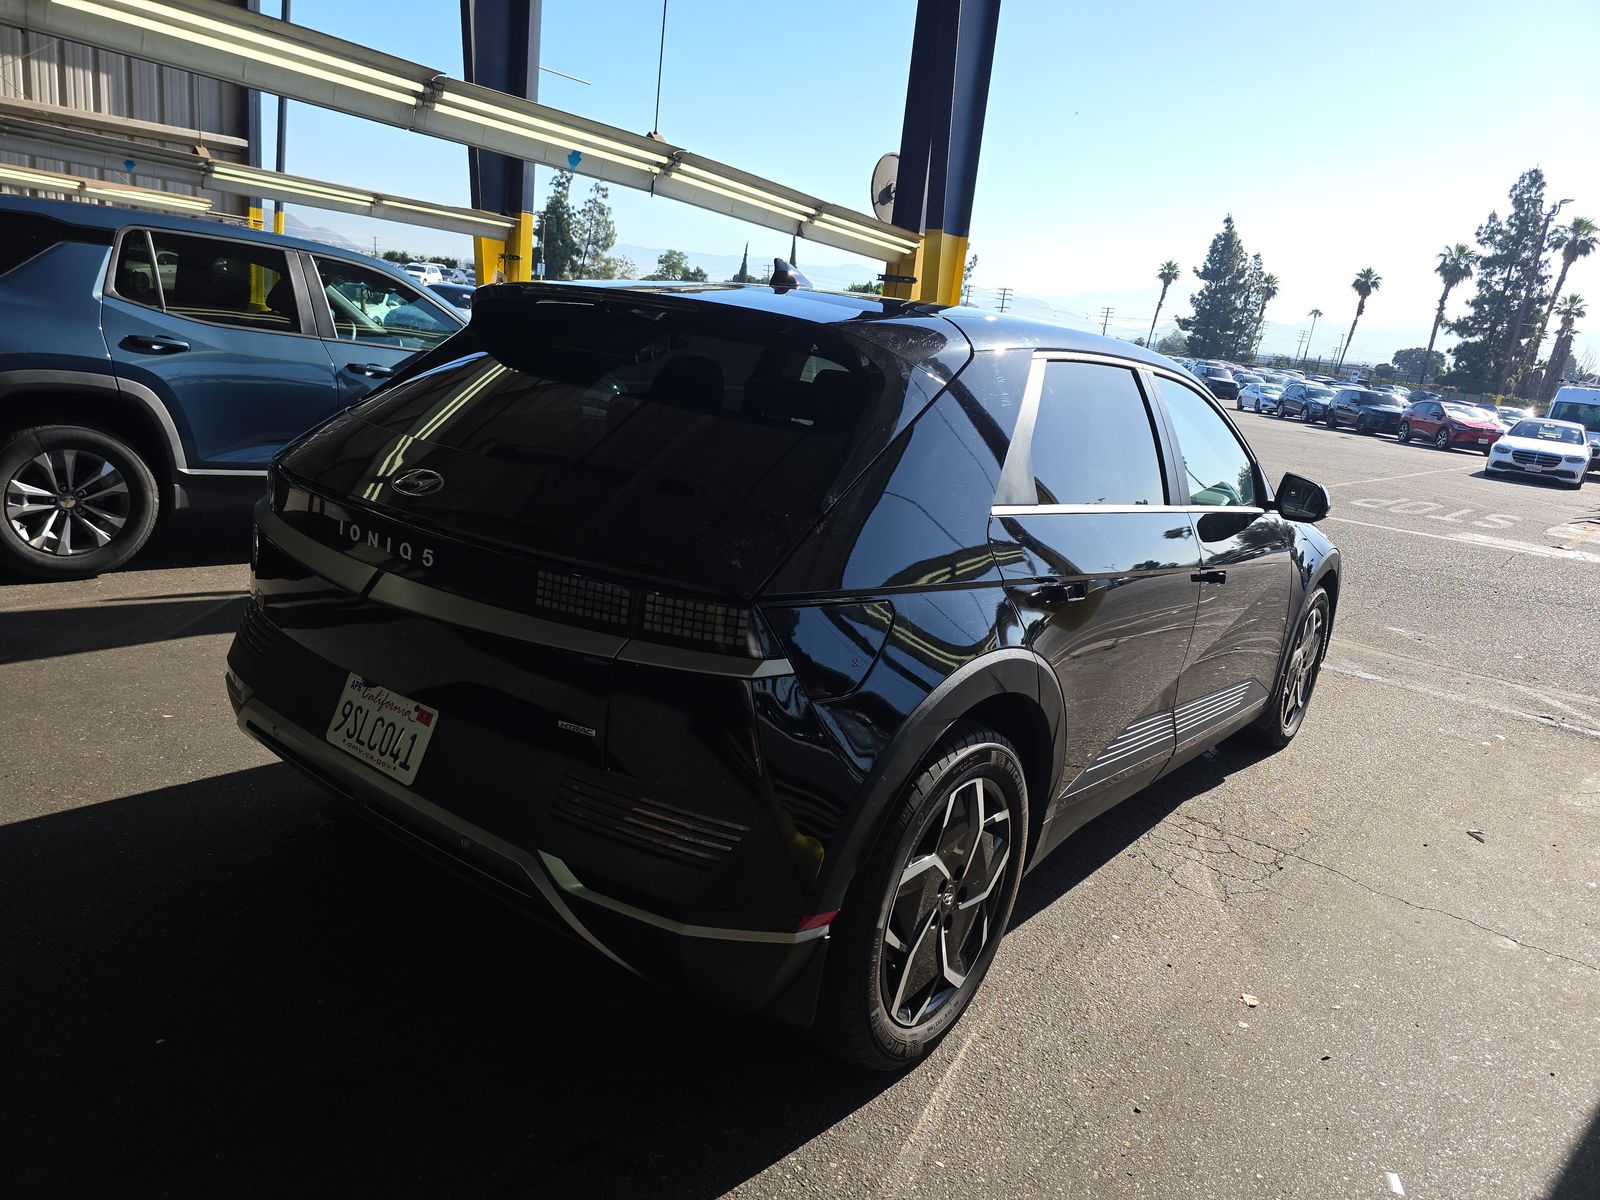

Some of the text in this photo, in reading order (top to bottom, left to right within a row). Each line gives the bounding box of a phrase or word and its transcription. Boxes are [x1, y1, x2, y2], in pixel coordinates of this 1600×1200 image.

[1350, 498, 1523, 529] STOP
[339, 519, 434, 567] IONIQ 5
[350, 679, 363, 692] APR
[361, 686, 416, 722] California
[333, 700, 418, 772] 9SLC041
[559, 721, 594, 736] HTRAC
[346, 741, 392, 770] dmv.ca.gov
[871, 1012, 906, 1058] MICHELIN
